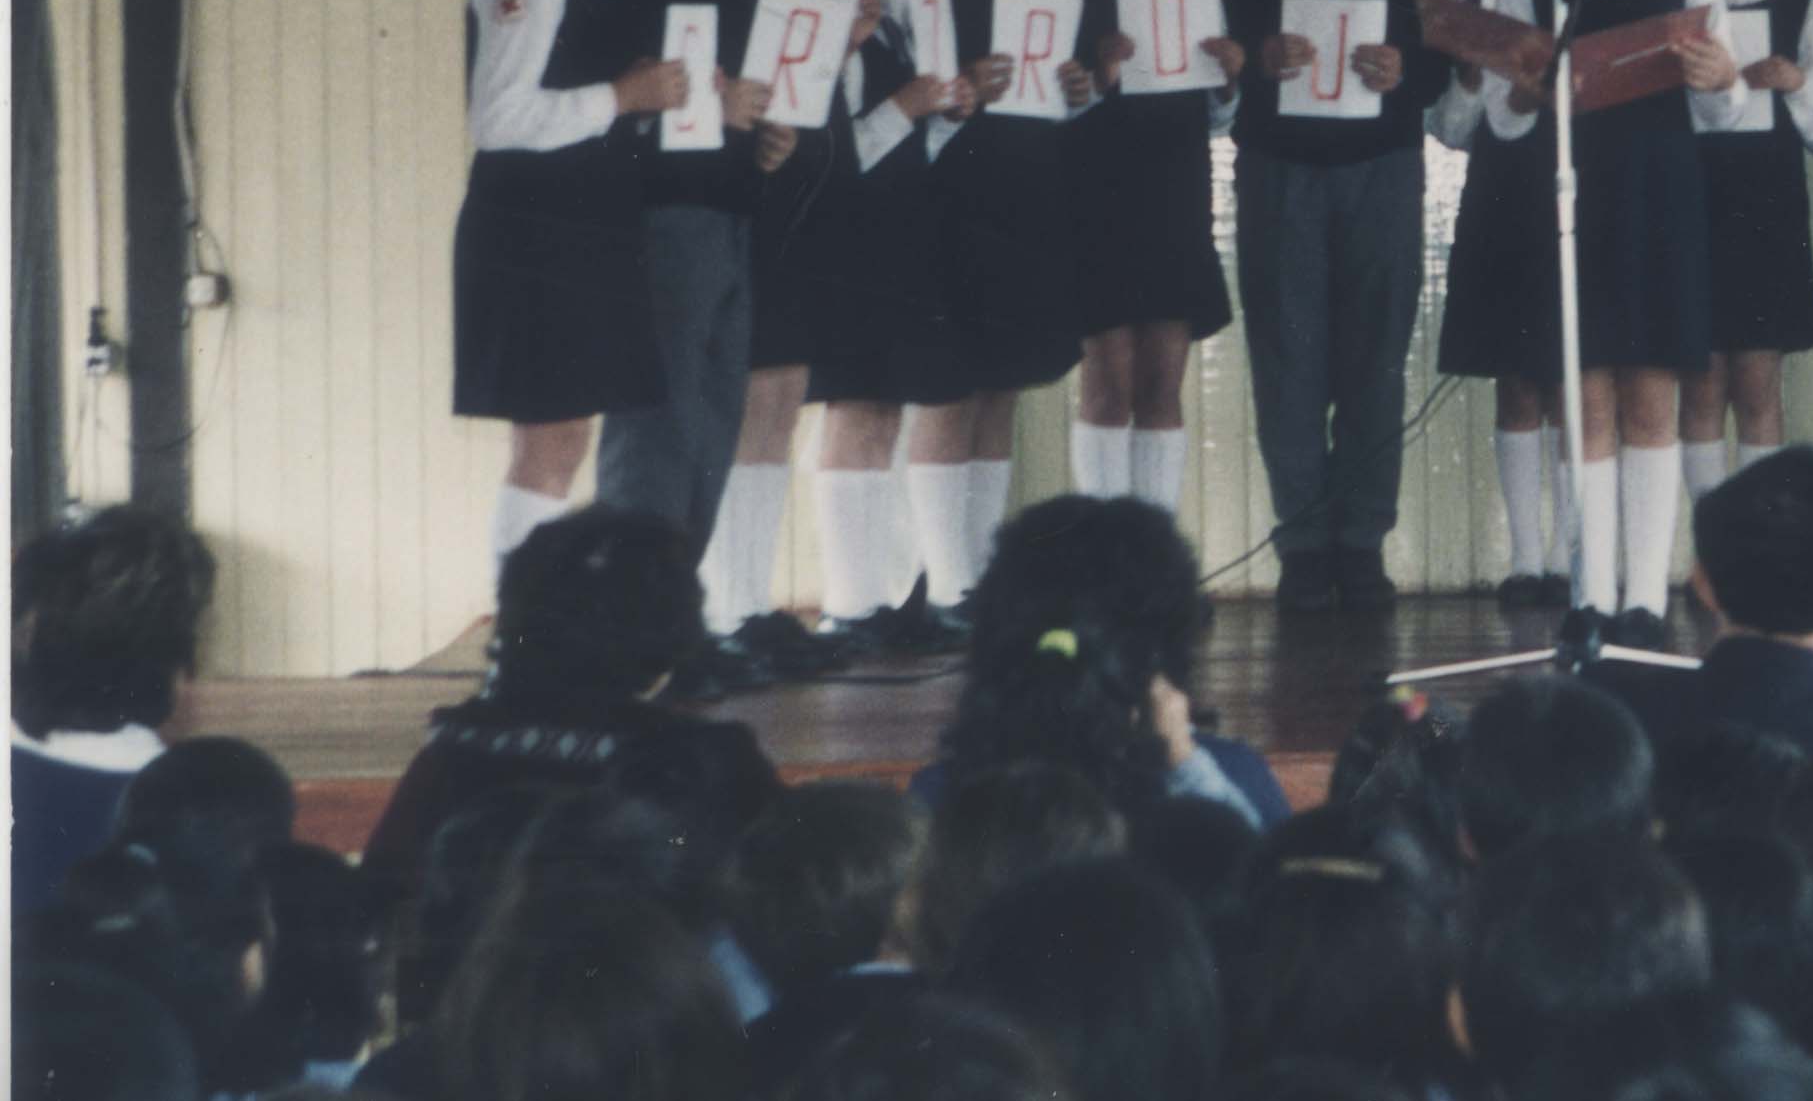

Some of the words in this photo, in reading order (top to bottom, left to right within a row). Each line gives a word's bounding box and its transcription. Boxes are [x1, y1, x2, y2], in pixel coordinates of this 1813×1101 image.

[768, 8, 822, 111] R
[1017, 8, 1056, 104] R
[1311, 12, 1348, 102] J
